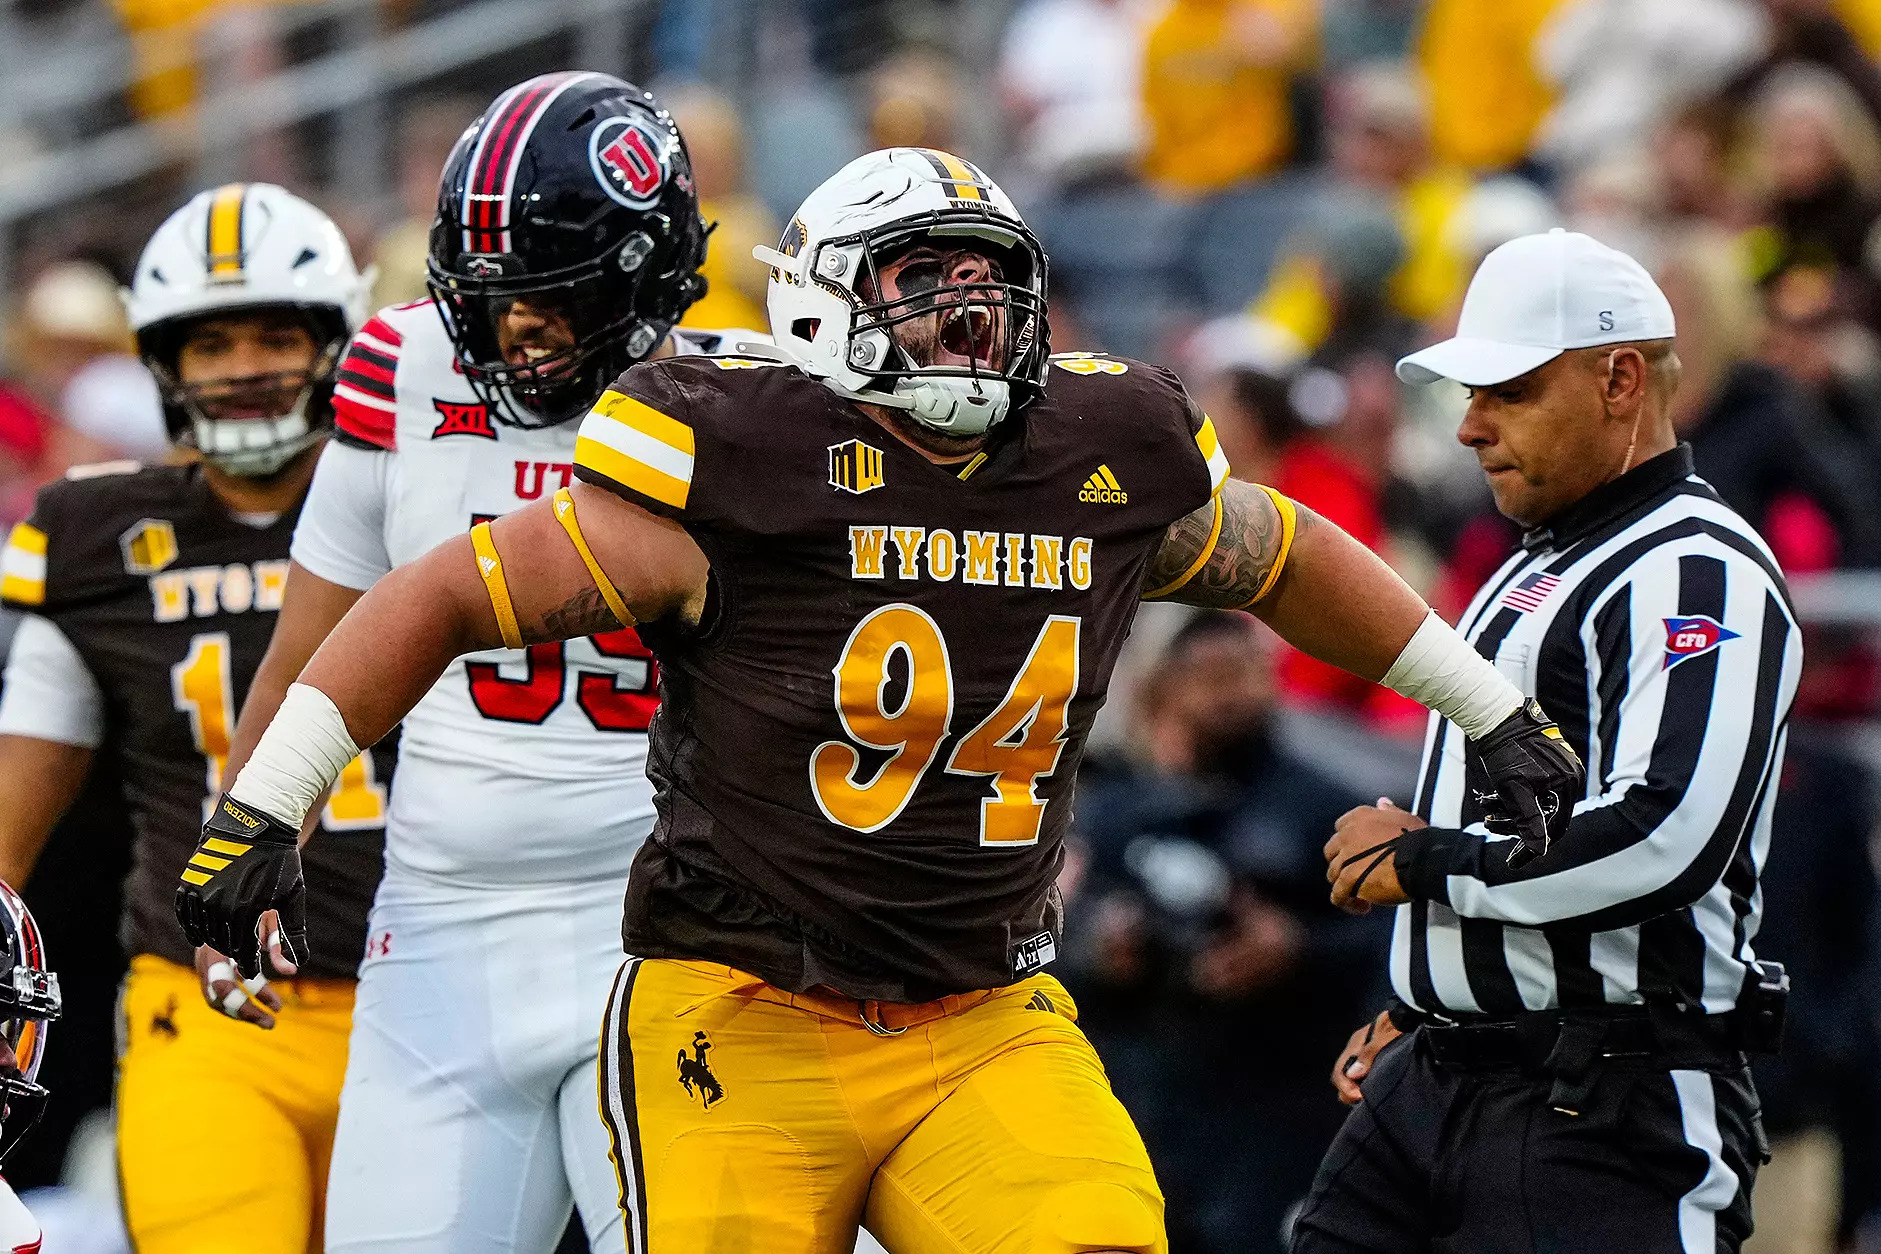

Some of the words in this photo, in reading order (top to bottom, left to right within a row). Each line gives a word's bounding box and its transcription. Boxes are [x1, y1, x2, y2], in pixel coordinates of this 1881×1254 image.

[599, 125, 662, 199] U
[949, 200, 1000, 213] WYOMING
[1599, 310, 1614, 331] S
[515, 461, 573, 500] UT
[827, 438, 885, 494] MW
[1079, 488, 1128, 504] adidas
[849, 525, 1093, 592] WYOMING
[149, 558, 291, 623] WYOM
[1675, 632, 1708, 648] CFO
[809, 603, 1082, 847] 94
[223, 801, 260, 828] ADIZERO
